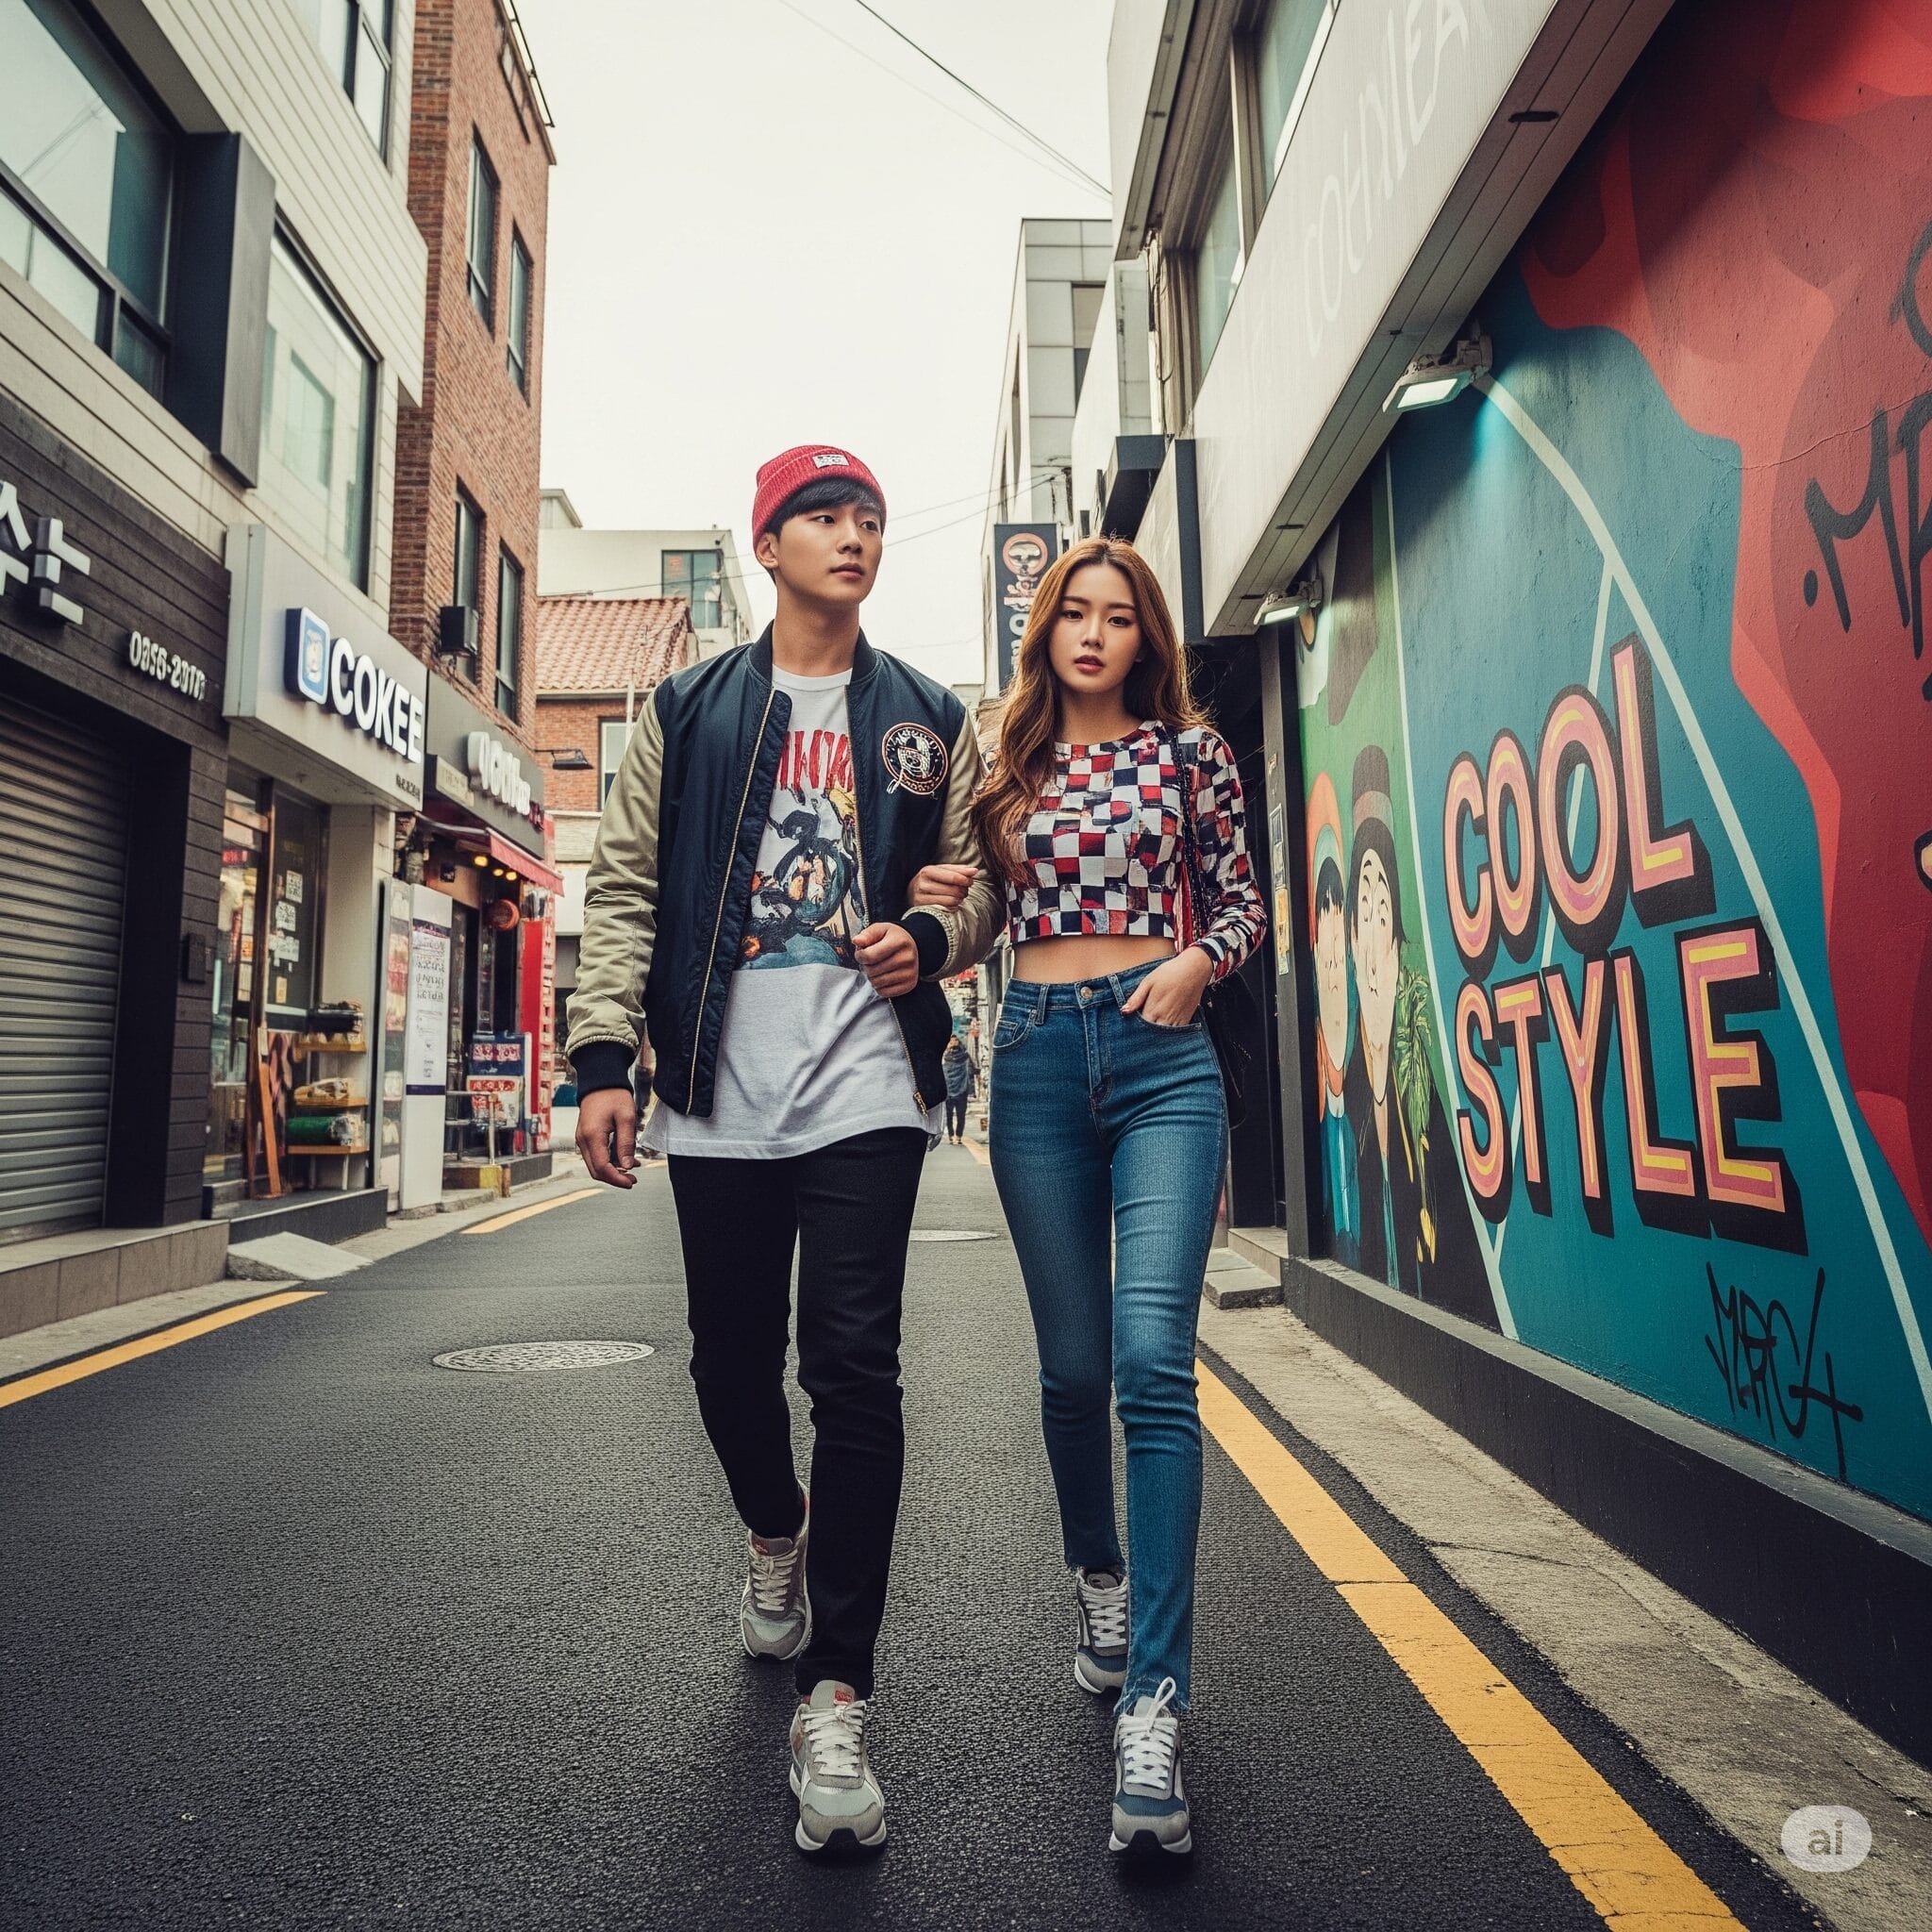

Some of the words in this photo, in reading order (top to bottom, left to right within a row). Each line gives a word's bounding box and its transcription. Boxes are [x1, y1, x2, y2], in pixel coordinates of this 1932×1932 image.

[331, 637, 425, 765] COKEE
[1441, 636, 1713, 977] COOL
[1454, 919, 1807, 1255] STYLE
